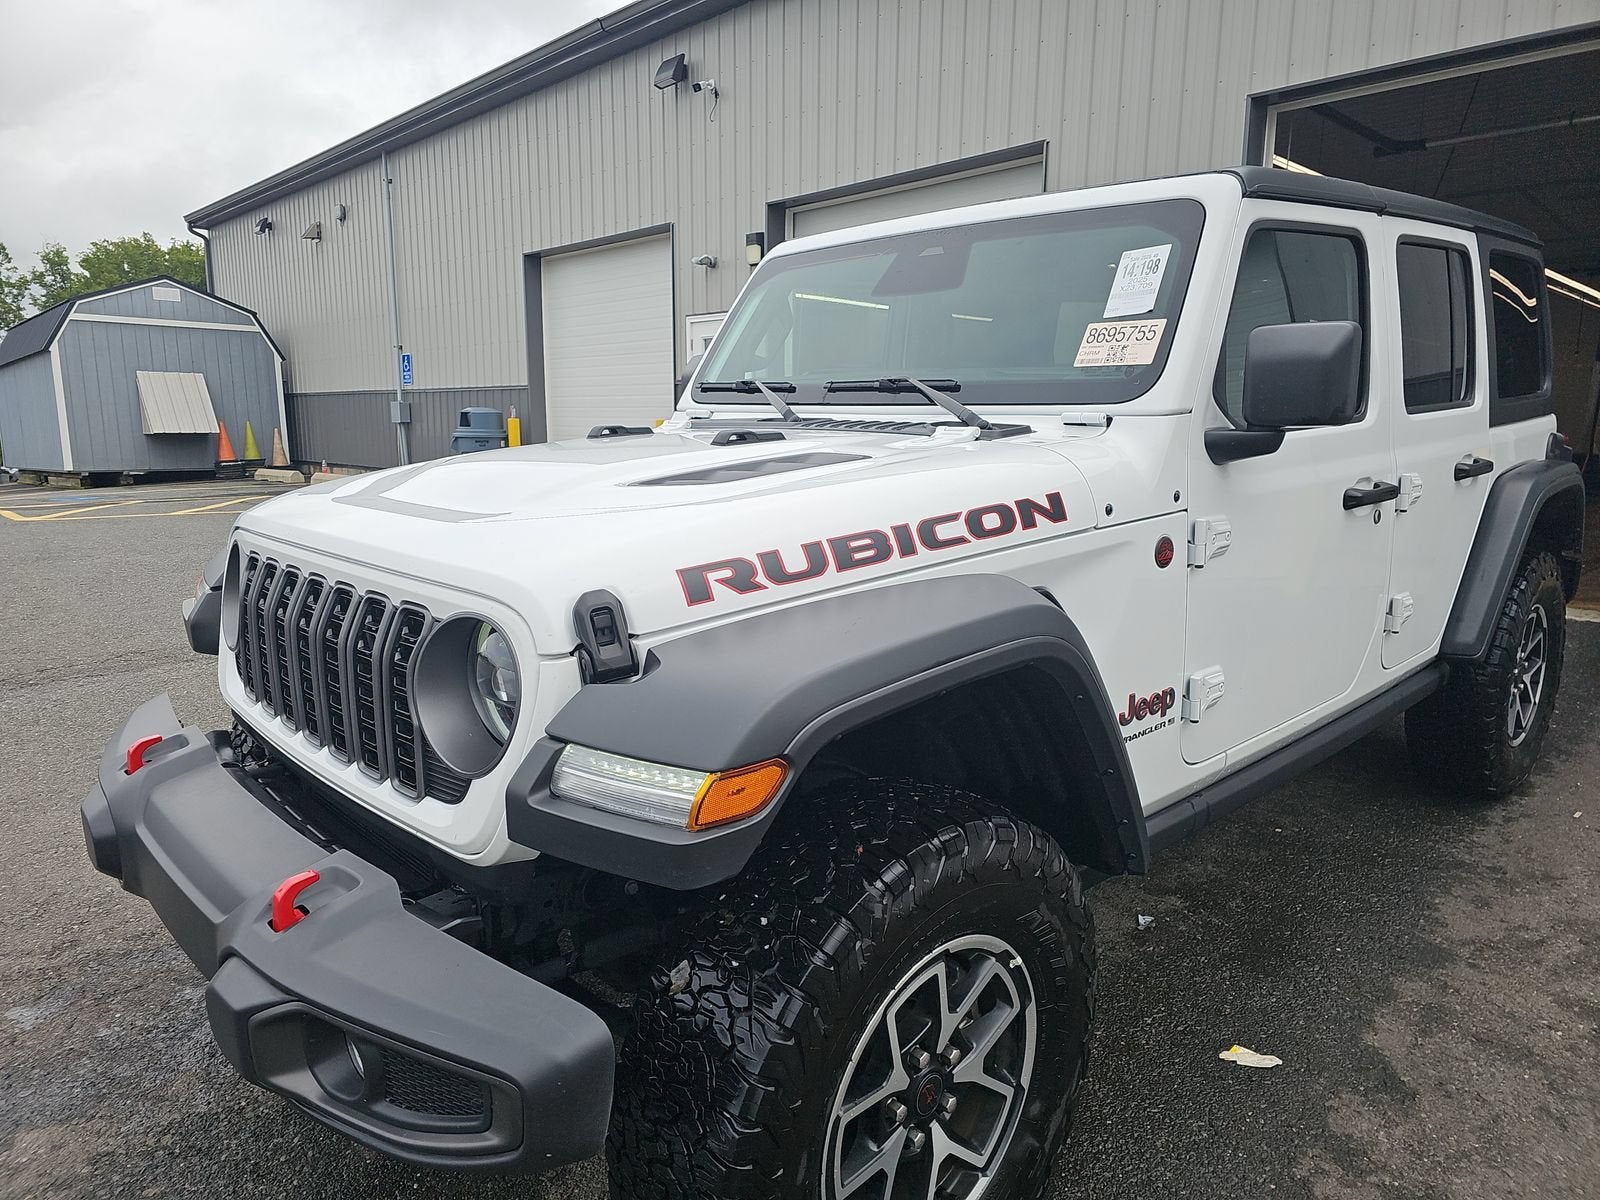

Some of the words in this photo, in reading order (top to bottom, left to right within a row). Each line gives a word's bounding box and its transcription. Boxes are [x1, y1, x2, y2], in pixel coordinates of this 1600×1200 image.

[1086, 324, 1160, 344] 8695755
[675, 491, 1069, 607] RUBICON
[1118, 686, 1176, 726] Jeep
[1123, 721, 1167, 744] RANGLER
